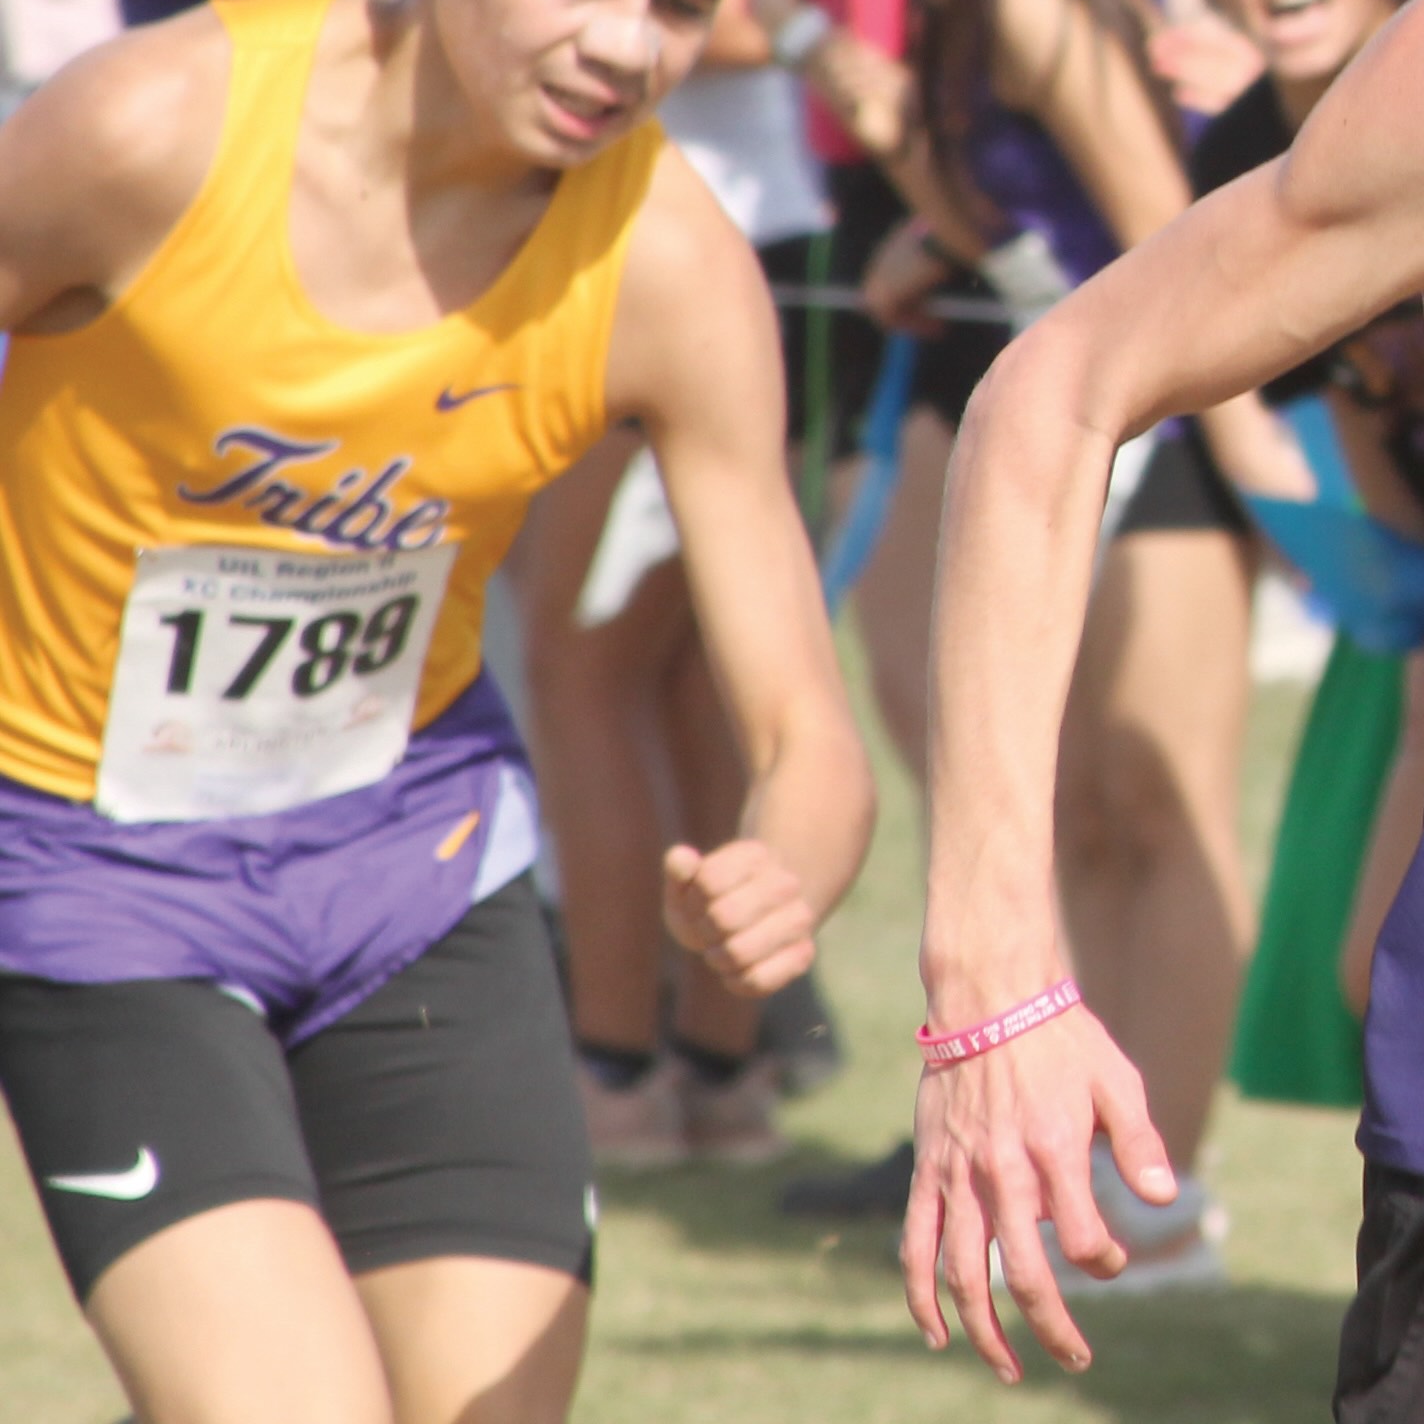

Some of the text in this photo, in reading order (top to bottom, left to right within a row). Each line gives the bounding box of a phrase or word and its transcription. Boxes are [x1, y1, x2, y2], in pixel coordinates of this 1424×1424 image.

[177, 426, 450, 552] Tribe
[218, 556, 260, 576] UIL
[160, 592, 422, 701] 1789
